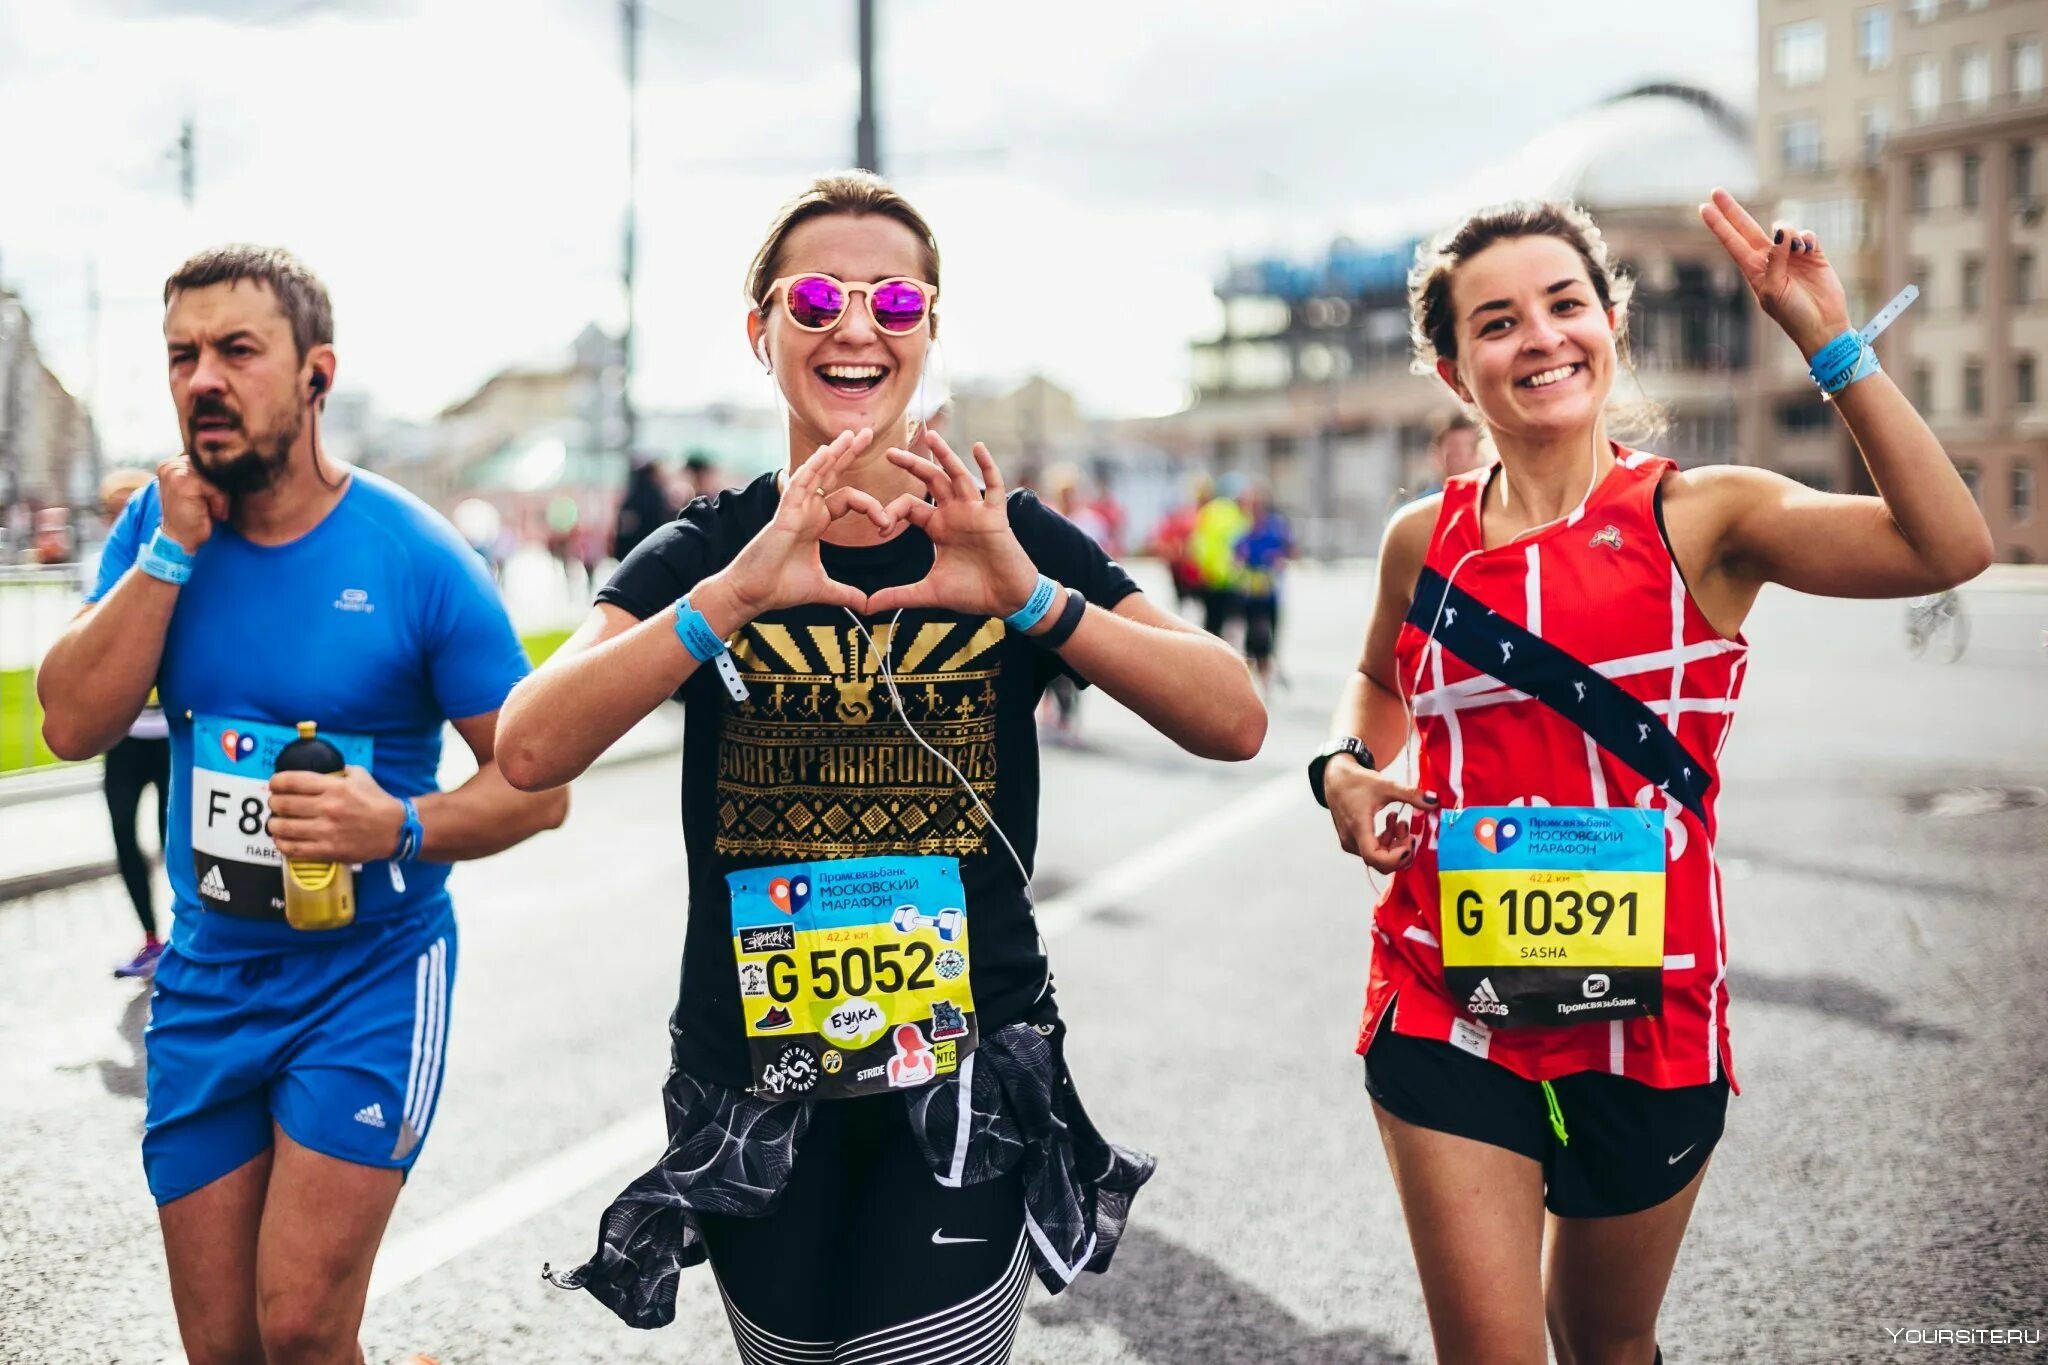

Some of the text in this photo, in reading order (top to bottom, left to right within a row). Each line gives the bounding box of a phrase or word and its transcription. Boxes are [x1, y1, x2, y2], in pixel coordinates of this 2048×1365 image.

[208, 788, 231, 828] F
[1529, 816, 1611, 829] Промсвязьбанк
[246, 844, 280, 858] ПАВЕ
[1529, 842, 1597, 855] МАРАФОН
[819, 866, 906, 884] Промсвязьбанк
[820, 877, 919, 898] МОСКОВСКИЙ
[822, 895, 892, 912] МАРАФОН
[1456, 889, 1638, 936] G 10391
[826, 931, 869, 942] 42,2 км
[1520, 946, 1568, 959] SASHA
[766, 953, 799, 1003] G
[810, 941, 935, 1000] 5052
[1467, 1001, 1509, 1016] adidas
[1557, 997, 1636, 1015] Промсвязьбанк
[831, 1007, 878, 1029] БУЛКА
[780, 1047, 815, 1074] GORKY PARK
[936, 1050, 956, 1064] NTC
[785, 1068, 818, 1092] RUNNERS
[856, 1064, 886, 1082] STRIDE
